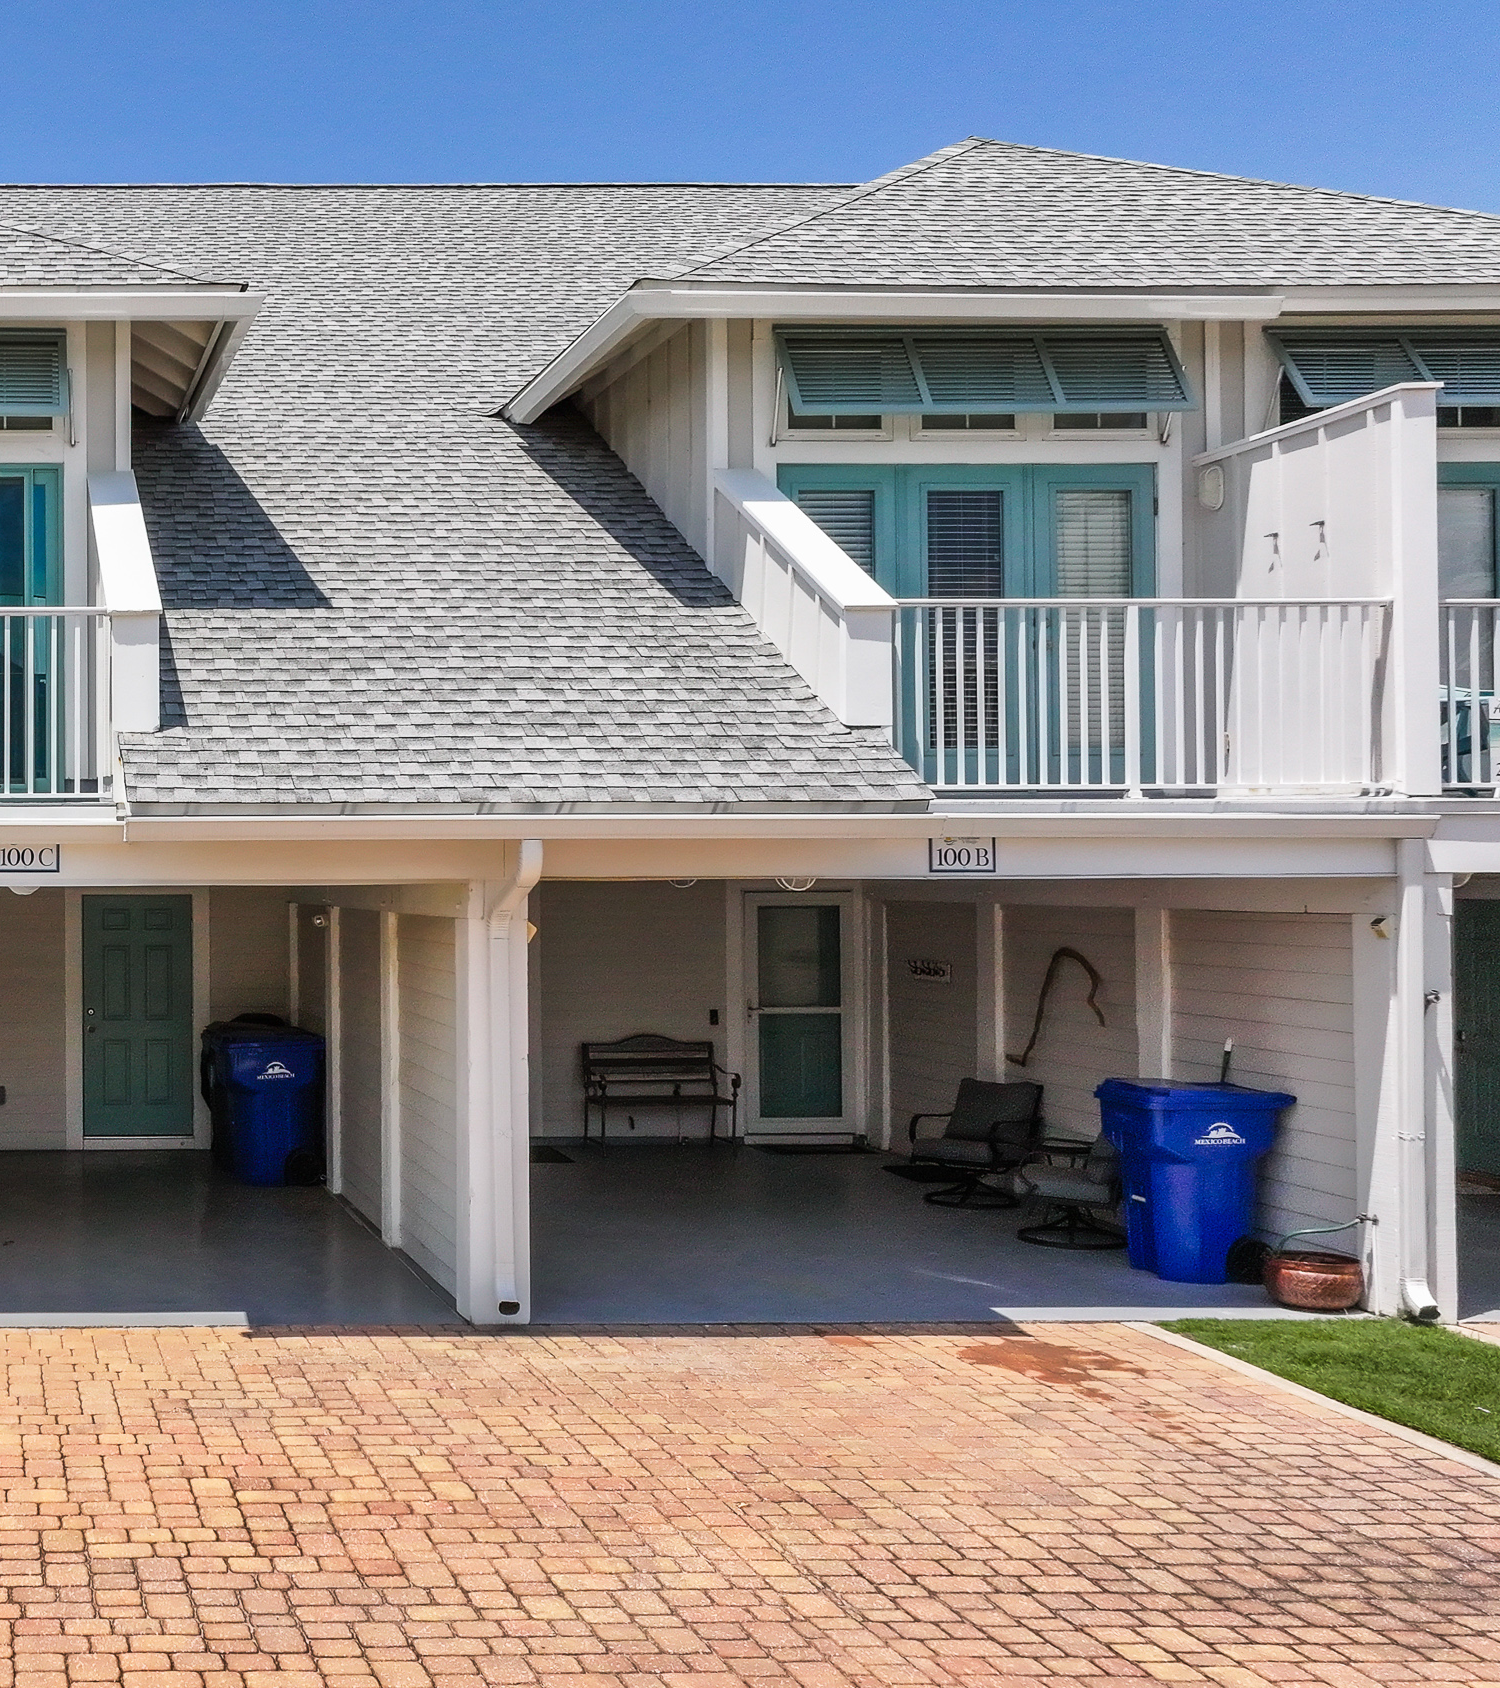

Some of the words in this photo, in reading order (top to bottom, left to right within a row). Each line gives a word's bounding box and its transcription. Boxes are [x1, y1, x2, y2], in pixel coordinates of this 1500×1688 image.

[0, 847, 35, 867] 100
[38, 847, 54, 867] C
[937, 847, 971, 867] 100
[975, 847, 990, 867] B
